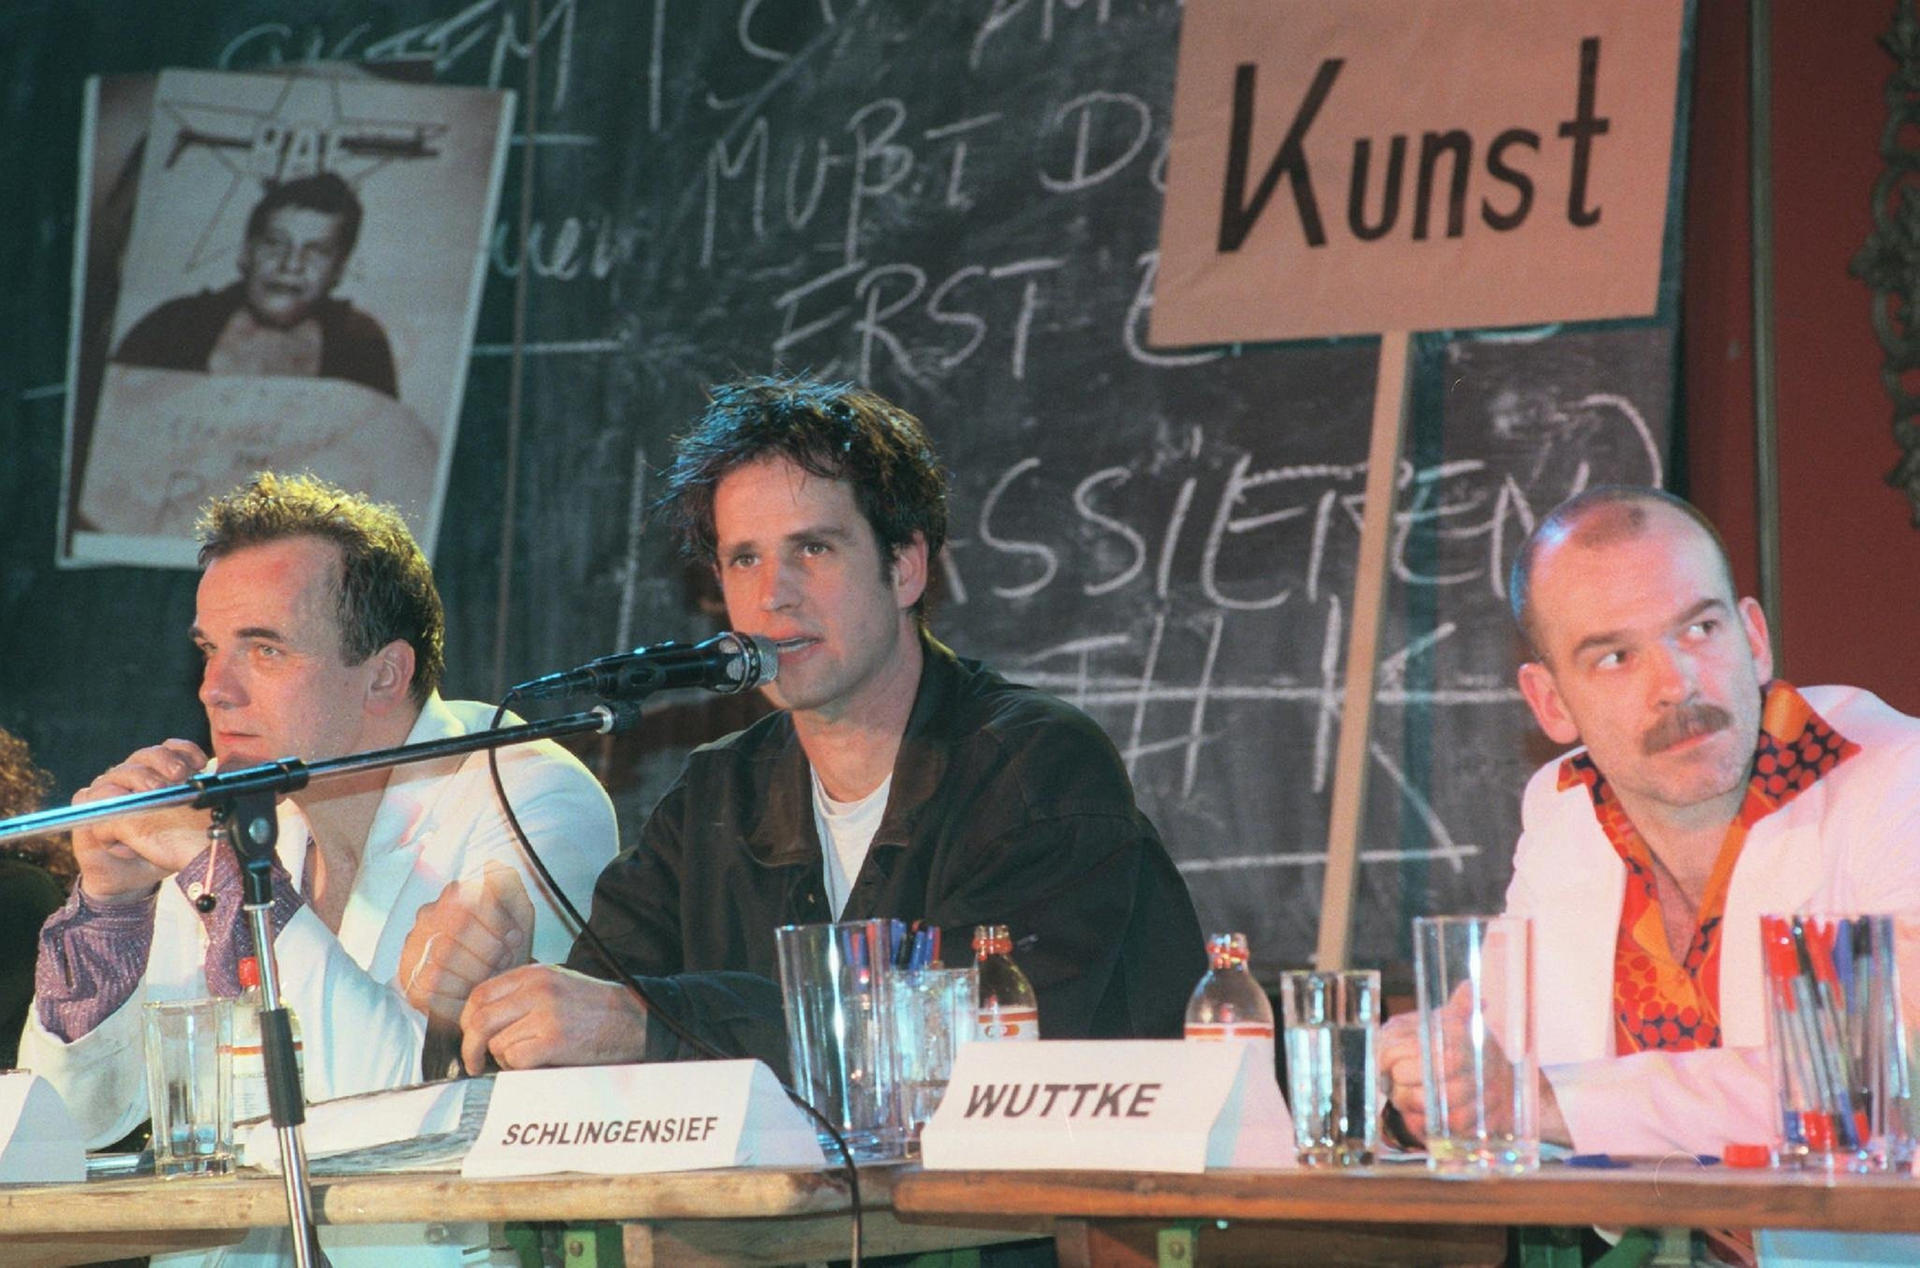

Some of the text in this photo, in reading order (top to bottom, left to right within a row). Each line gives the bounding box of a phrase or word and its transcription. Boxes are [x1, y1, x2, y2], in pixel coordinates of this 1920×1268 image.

[1217, 36, 1610, 255] Kunst
[963, 1081, 1164, 1119] WUTTKE
[501, 1116, 719, 1146] SCHLINGENSIEF
